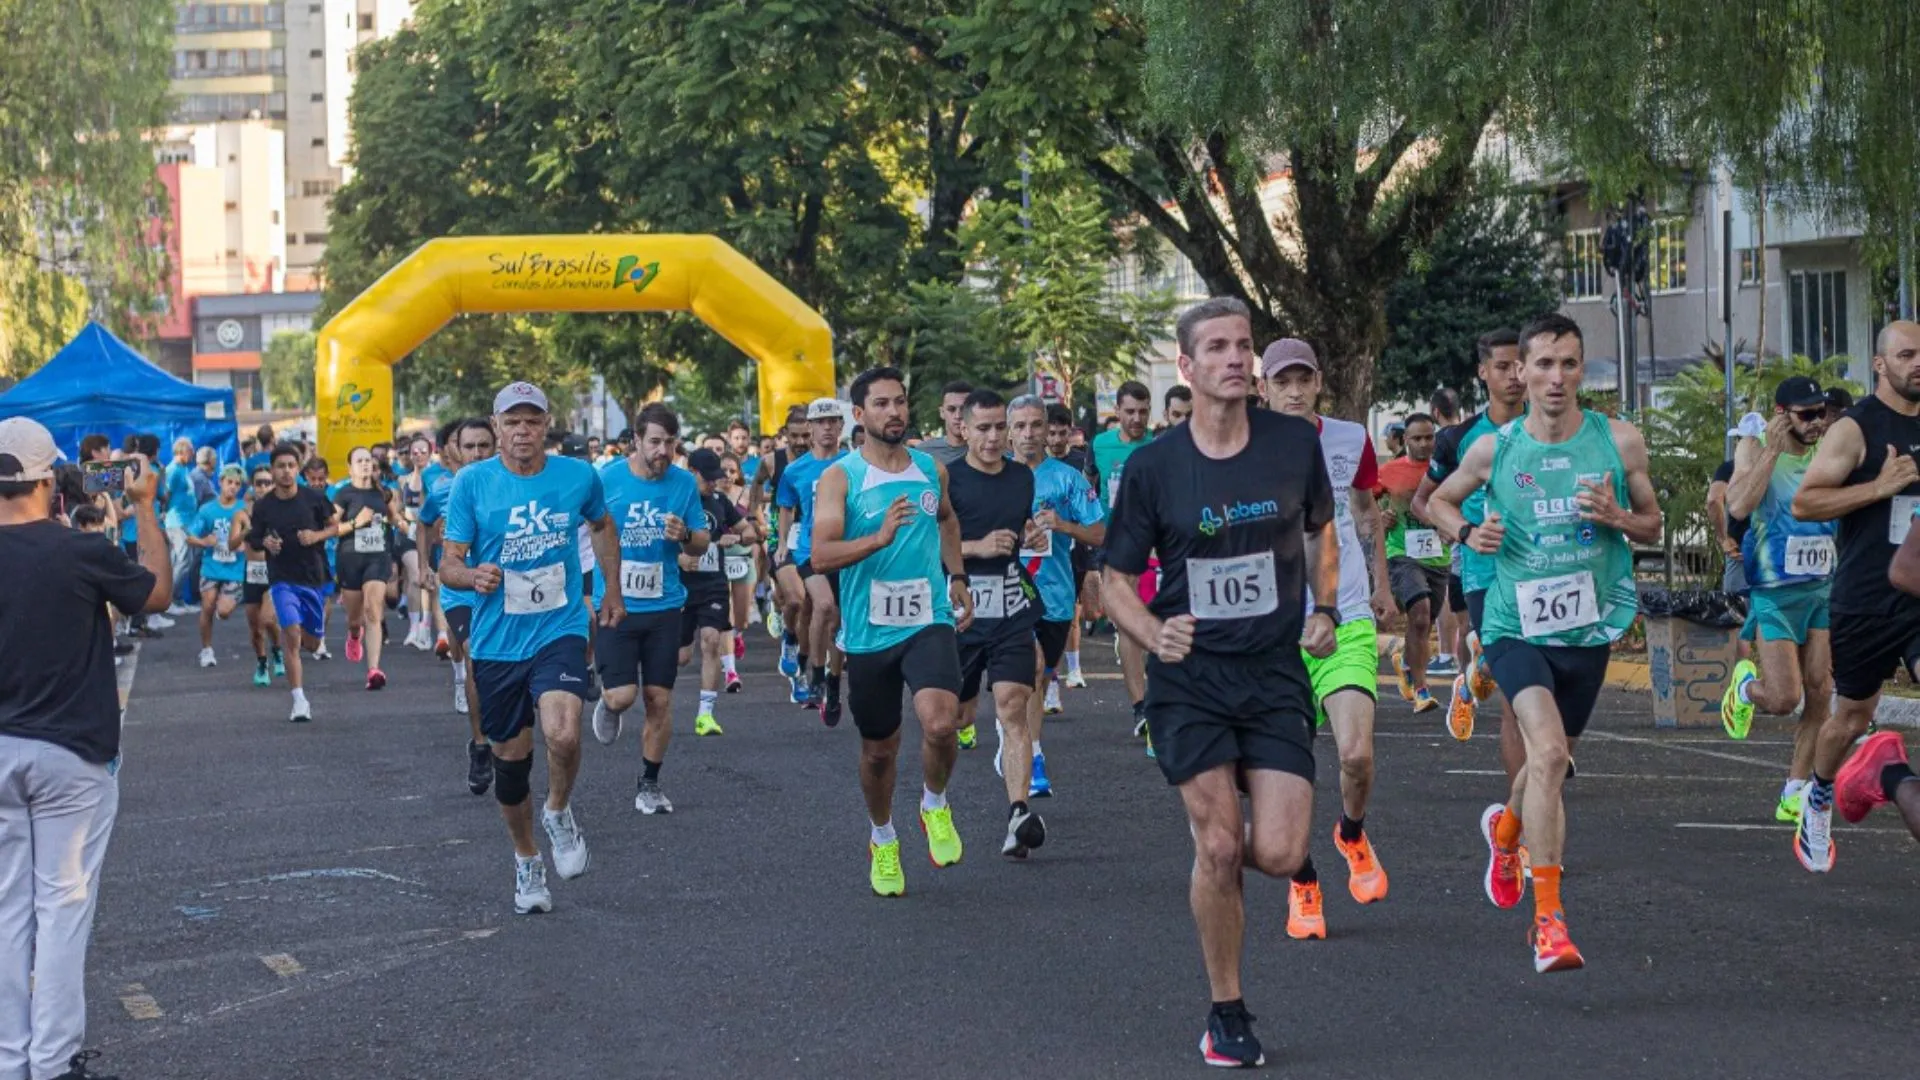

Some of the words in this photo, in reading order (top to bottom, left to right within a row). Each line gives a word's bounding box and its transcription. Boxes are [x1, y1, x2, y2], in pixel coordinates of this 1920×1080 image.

[1796, 548, 1827, 567] 109
[625, 572, 656, 592] 104
[1205, 574, 1261, 606] 105
[531, 584, 544, 604] 6
[882, 594, 921, 617] 115
[1532, 589, 1580, 624] 267
